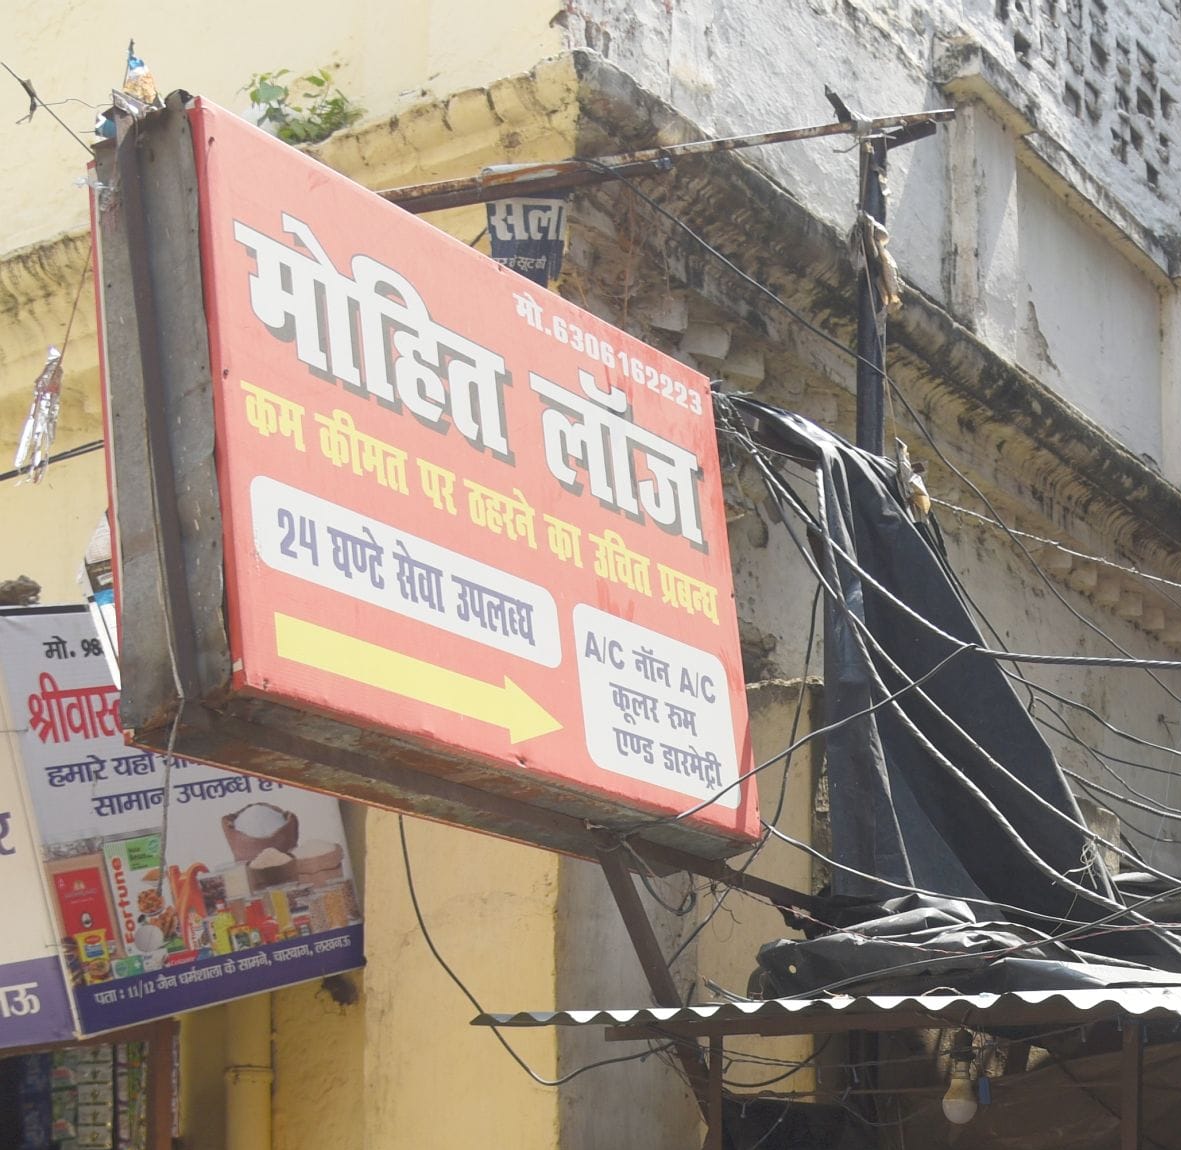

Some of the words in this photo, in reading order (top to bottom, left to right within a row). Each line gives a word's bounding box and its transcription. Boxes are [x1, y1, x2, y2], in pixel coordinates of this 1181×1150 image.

[232, 210, 509, 459] मोहित
[528, 367, 706, 548] लॉज
[240, 379, 306, 452] कम
[314, 408, 410, 496] कीमत
[416, 457, 457, 516] पर
[463, 478, 538, 549] ठहरने
[543, 513, 583, 568] का
[588, 528, 653, 597] उचित
[656, 563, 720, 626] प्रबन्ध
[277, 507, 319, 567] 24
[326, 526, 385, 590] घण्टे
[392, 539, 445, 613] सेवा
[451, 574, 536, 646] उपलब्ध
[42, 635, 76, 660] मो.
[81, 638, 105, 658] 98
[585, 631, 625, 670] A/C
[632, 646, 671, 688] नॉन
[679, 667, 716, 704] A/C
[609, 681, 660, 726] कूलर
[664, 701, 698, 737] रूम
[45, 755, 108, 787] हमारे
[612, 727, 654, 765] एण्ड
[91, 787, 167, 817] सामान
[173, 774, 252, 803] उपलब्ध
[111, 856, 137, 945] Fortune
